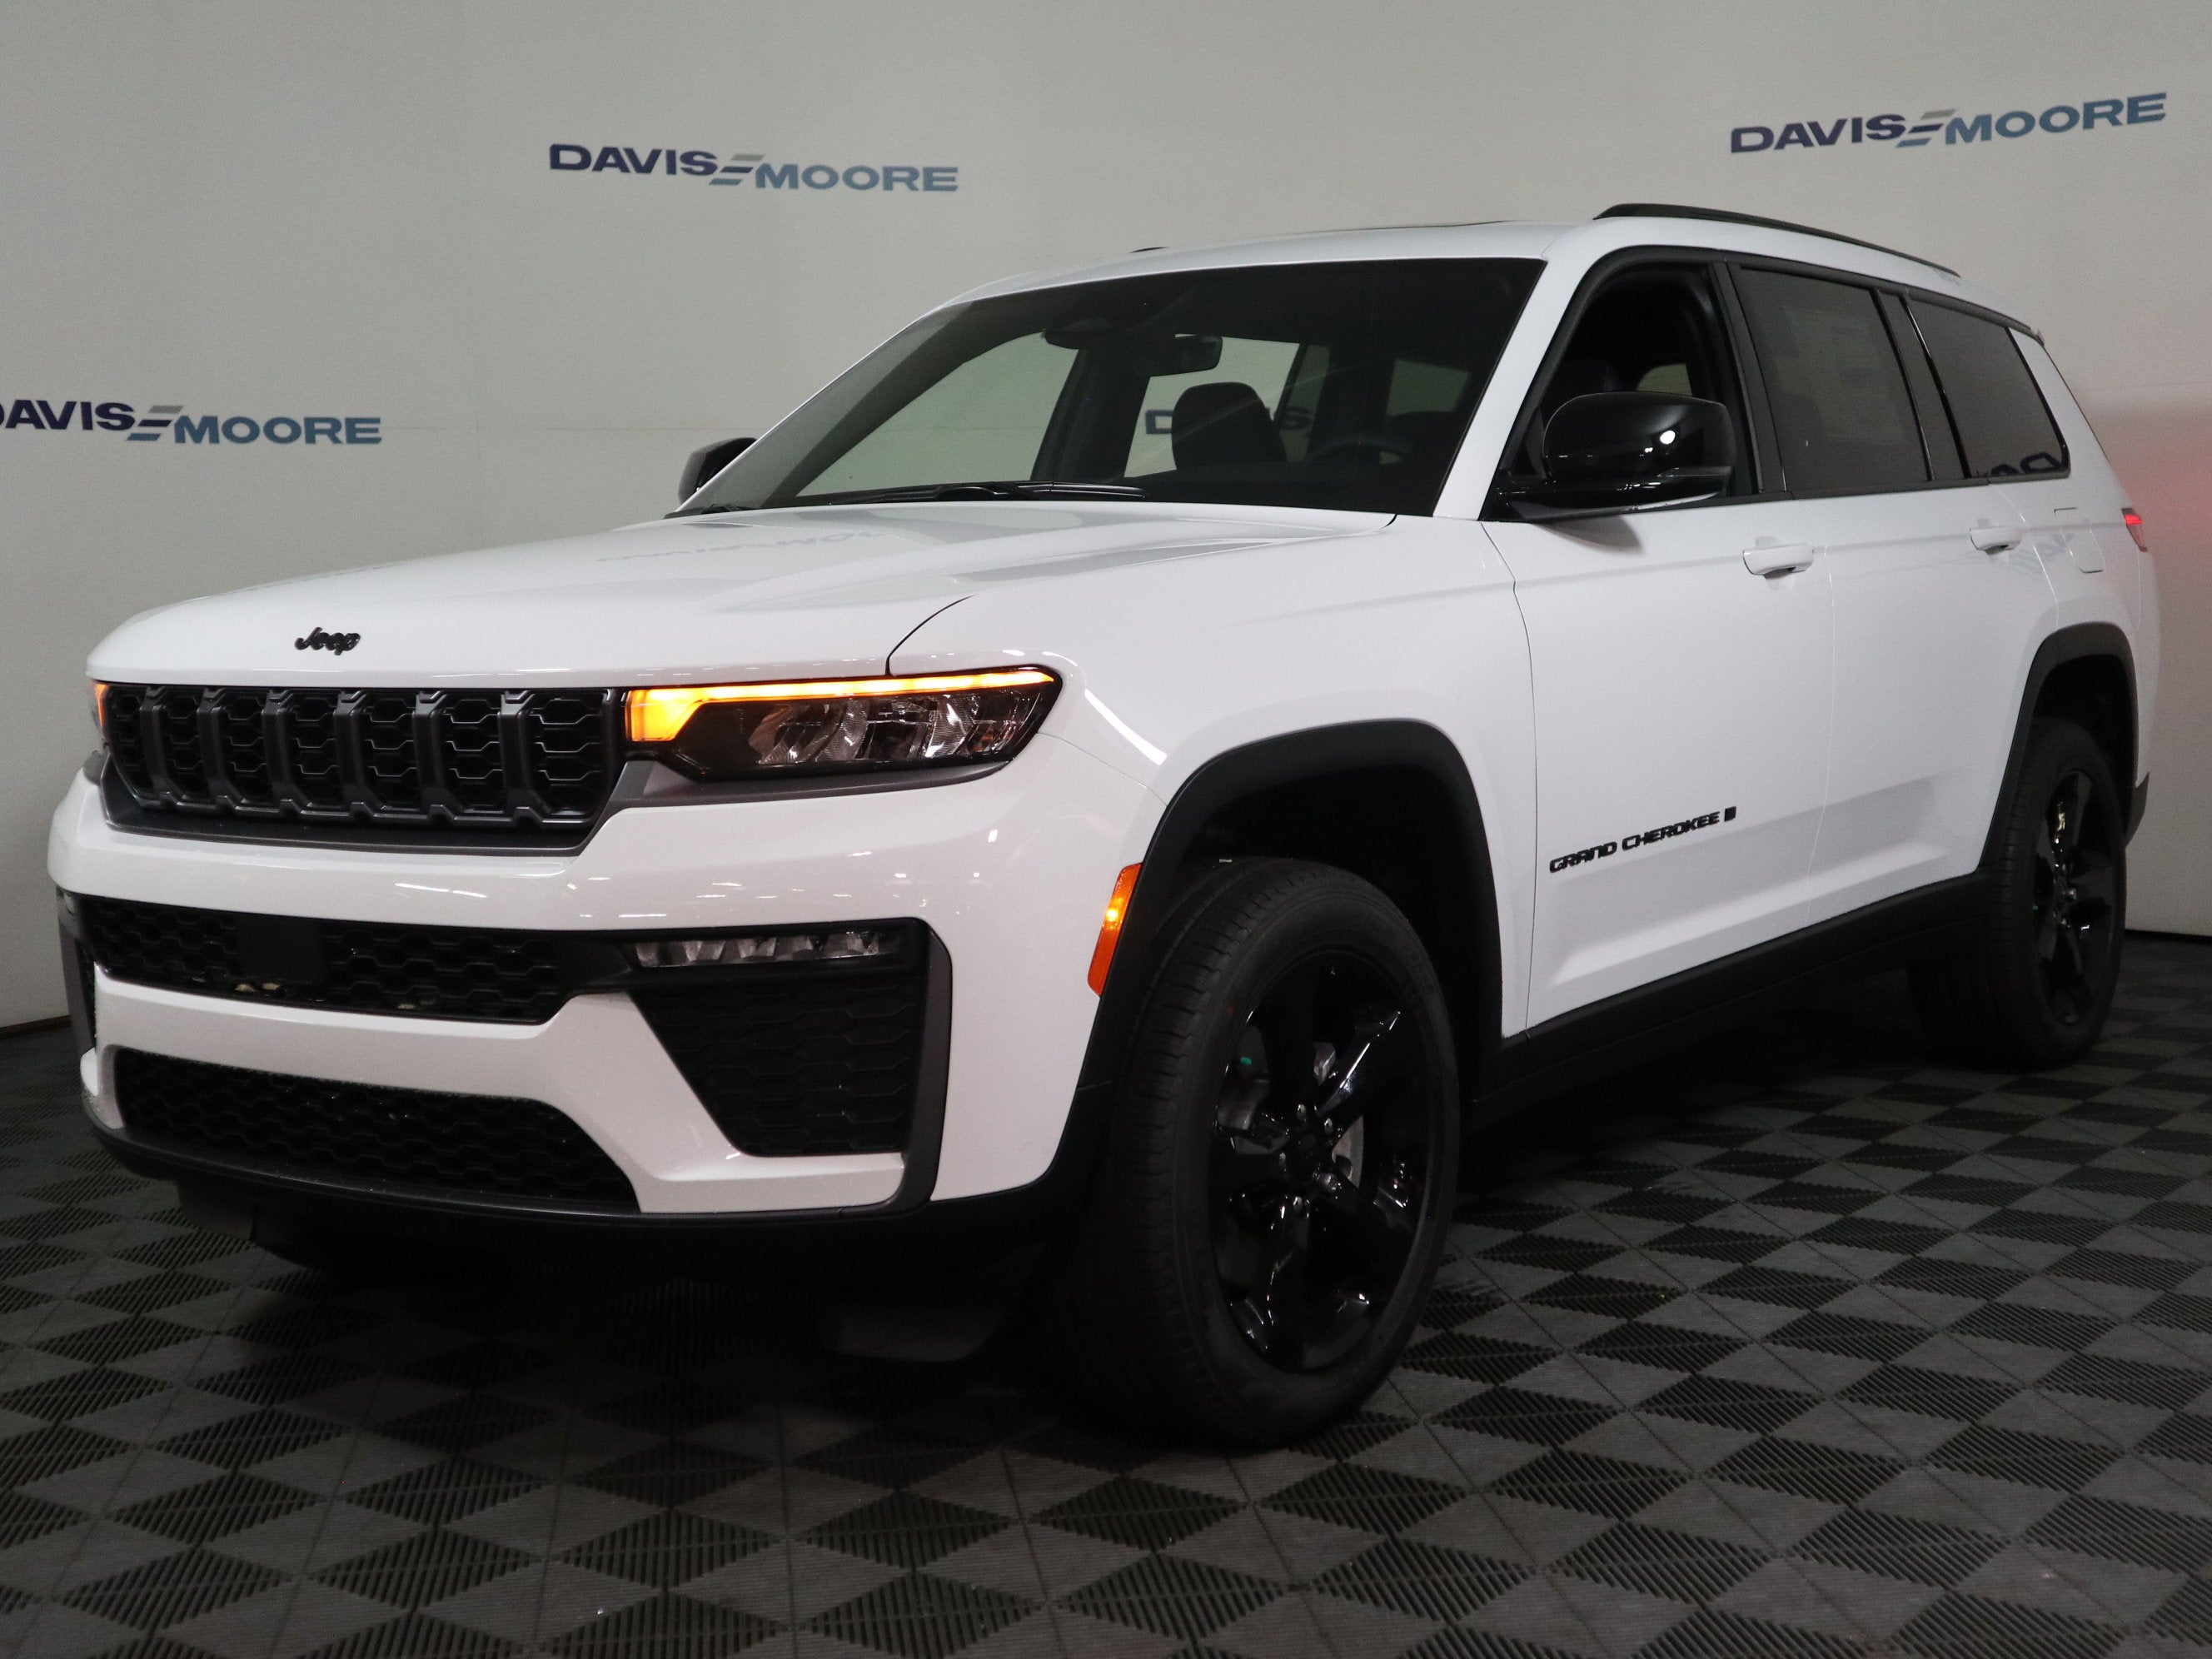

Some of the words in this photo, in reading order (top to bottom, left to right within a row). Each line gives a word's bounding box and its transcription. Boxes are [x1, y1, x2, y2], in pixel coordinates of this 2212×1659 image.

[1731, 113, 1907, 153] DAVIS
[1945, 92, 2167, 145] MOORE
[549, 143, 718, 176] DAVIS
[755, 163, 959, 192] MOORE
[0, 399, 135, 431] AVIS
[173, 415, 382, 445] MOORE
[294, 626, 361, 656] Jeep
[1549, 841, 1618, 874] GRAND
[1622, 810, 1721, 851] CHEROKEE
